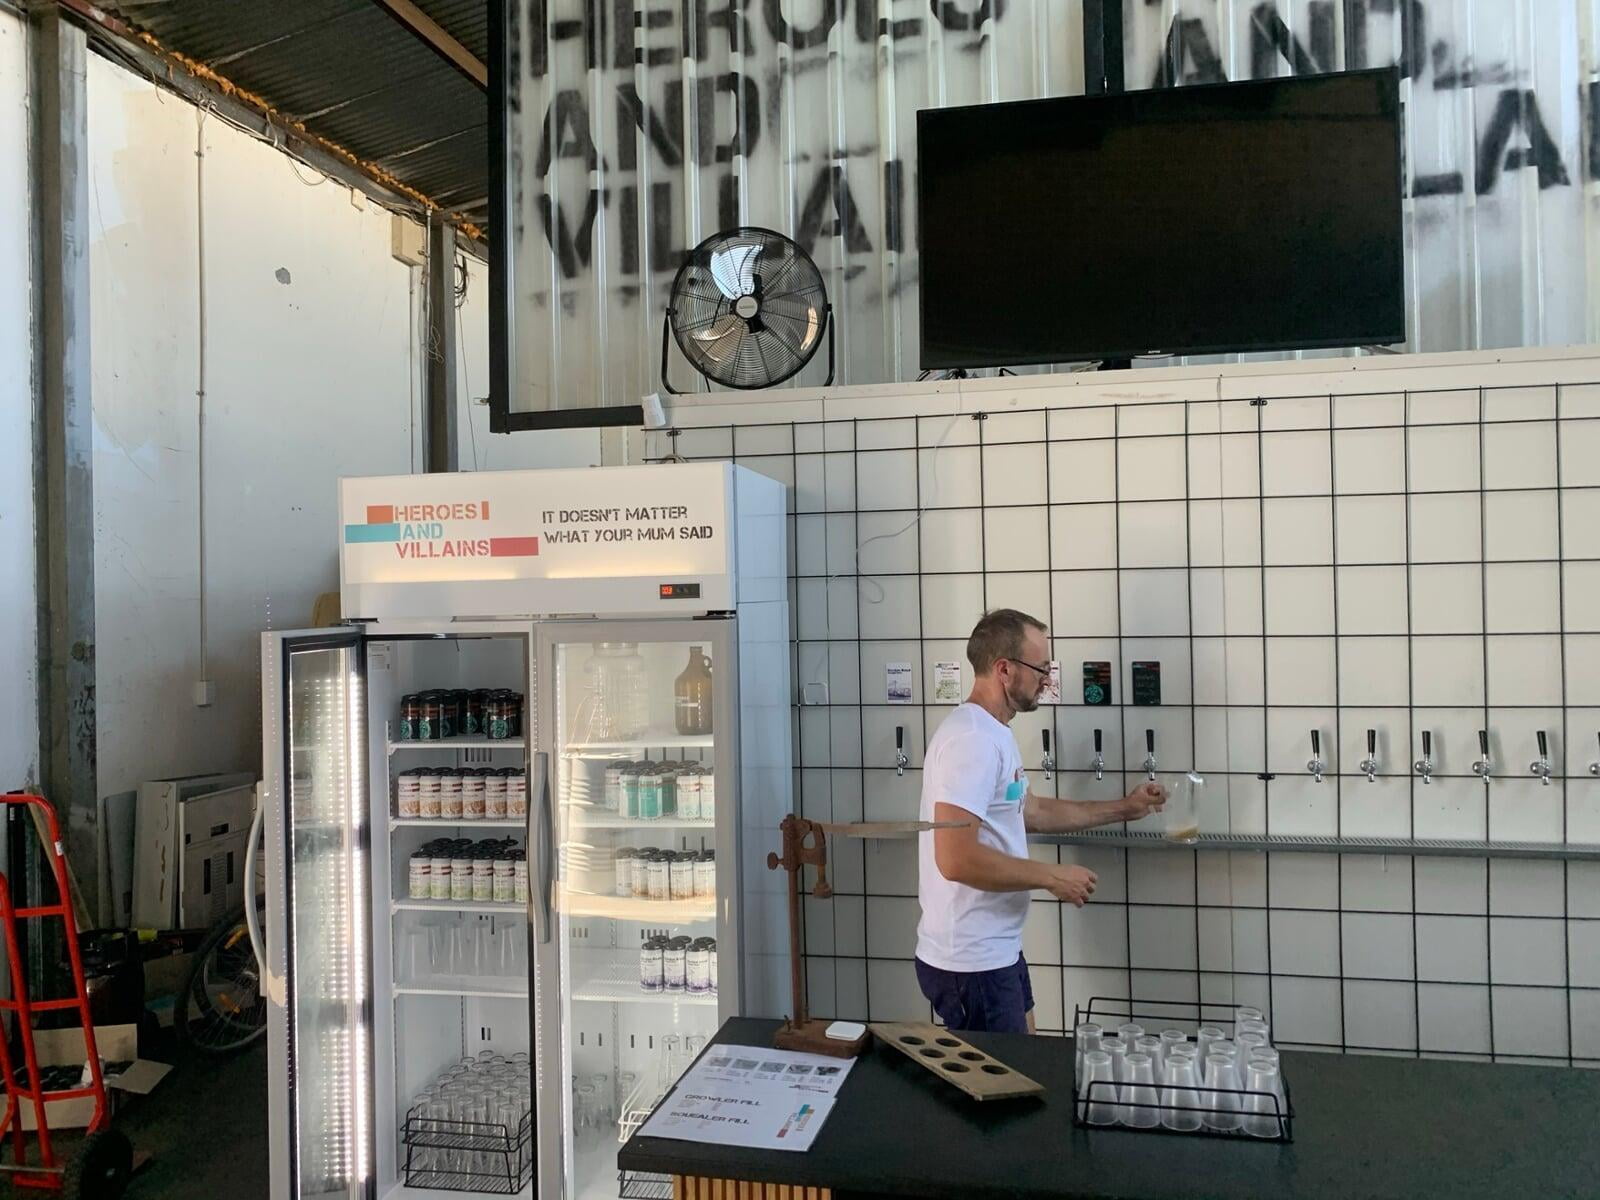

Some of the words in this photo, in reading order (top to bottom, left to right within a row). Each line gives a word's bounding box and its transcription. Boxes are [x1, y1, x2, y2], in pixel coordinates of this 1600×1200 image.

[536, 73, 760, 178] AND
[394, 504, 478, 522] HEROES
[542, 511, 555, 524] IT
[559, 508, 621, 523] DOESN'T
[625, 506, 688, 521] MATTER
[402, 523, 443, 540] AND
[544, 530, 590, 543] WHAT
[595, 528, 633, 542] YOUR
[637, 527, 675, 541] MUM
[679, 525, 713, 539] SAID
[395, 539, 489, 559] VILLAINS
[685, 1094, 738, 1104] GROWLER
